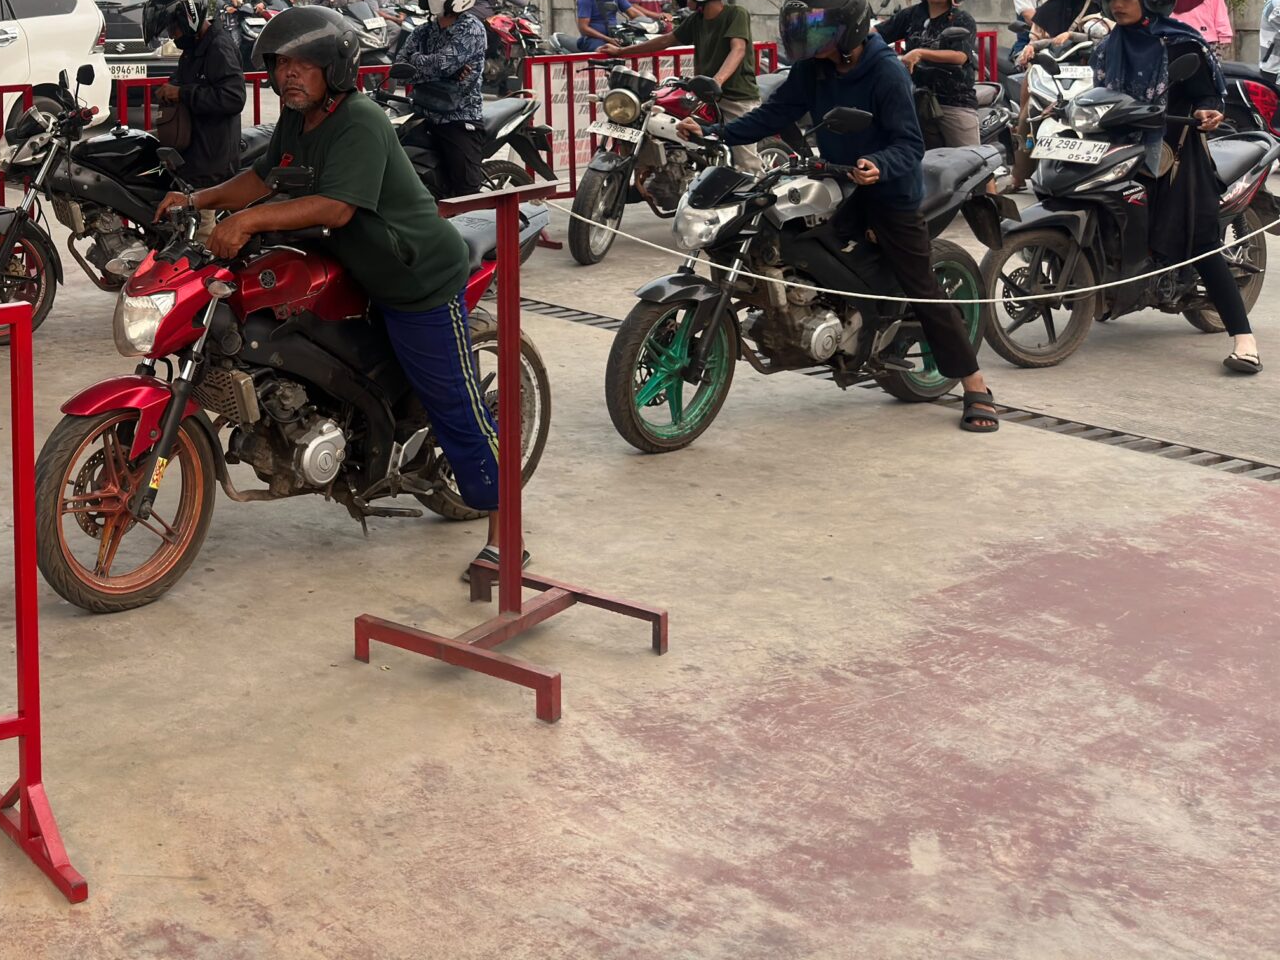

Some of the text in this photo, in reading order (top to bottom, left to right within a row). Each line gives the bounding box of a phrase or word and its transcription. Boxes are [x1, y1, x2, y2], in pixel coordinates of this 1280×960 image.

[111, 65, 146, 75] 8946 AH
[607, 123, 626, 134] 3906
[1037, 138, 1107, 153] KH 2981 YH
[1122, 186, 1143, 196] HONDA
